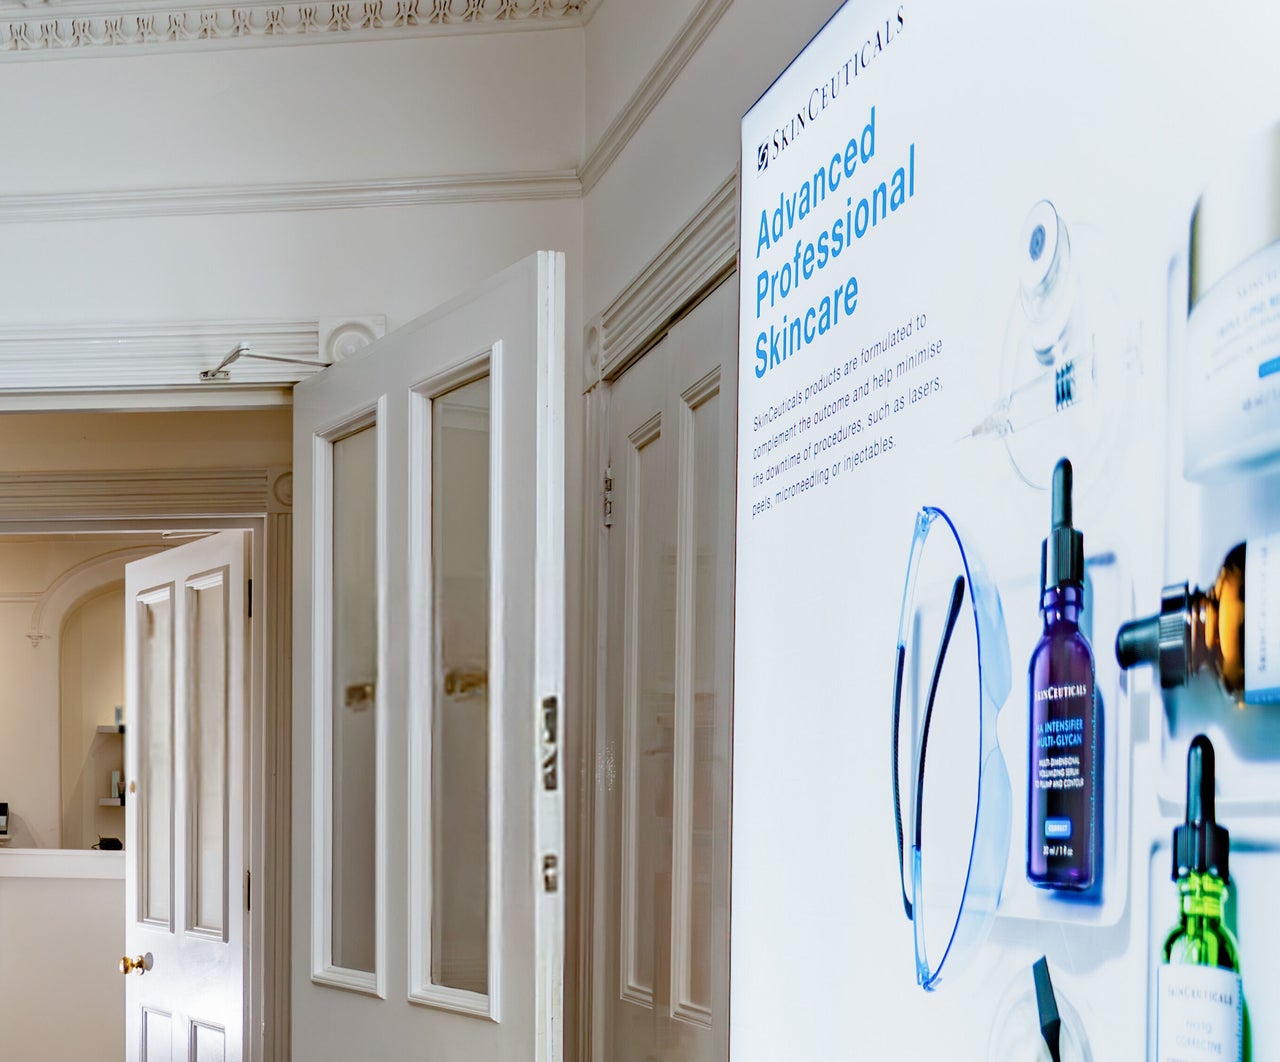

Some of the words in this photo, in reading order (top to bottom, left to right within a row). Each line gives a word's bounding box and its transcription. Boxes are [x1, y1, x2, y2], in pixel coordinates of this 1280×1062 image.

[772, 5, 904, 160] SKINCEUTICALS
[756, 105, 876, 258] Advanced
[757, 143, 914, 318] Professional
[754, 390, 802, 432] SkinCeuticals
[804, 367, 840, 405] products
[844, 357, 858, 376] are
[861, 318, 912, 365] formulated
[916, 313, 927, 331] to
[755, 276, 858, 378] Skincare
[752, 471, 764, 488] the
[766, 452, 800, 482] downtime
[804, 442, 812, 461] of
[814, 418, 864, 460] procedures,
[868, 401, 890, 427] such
[894, 395, 904, 413] as
[909, 376, 942, 405] lasers,
[753, 425, 796, 460] complement
[799, 416, 812, 433] the
[814, 392, 850, 426] outcome
[852, 382, 869, 403] and
[872, 368, 892, 391] help
[896, 339, 942, 377] minimise
[752, 496, 773, 520] peels,
[775, 470, 830, 504] microneedling
[832, 461, 841, 478] or
[844, 435, 896, 473] injectables.
[1044, 718, 1083, 734] INTENSIFIER
